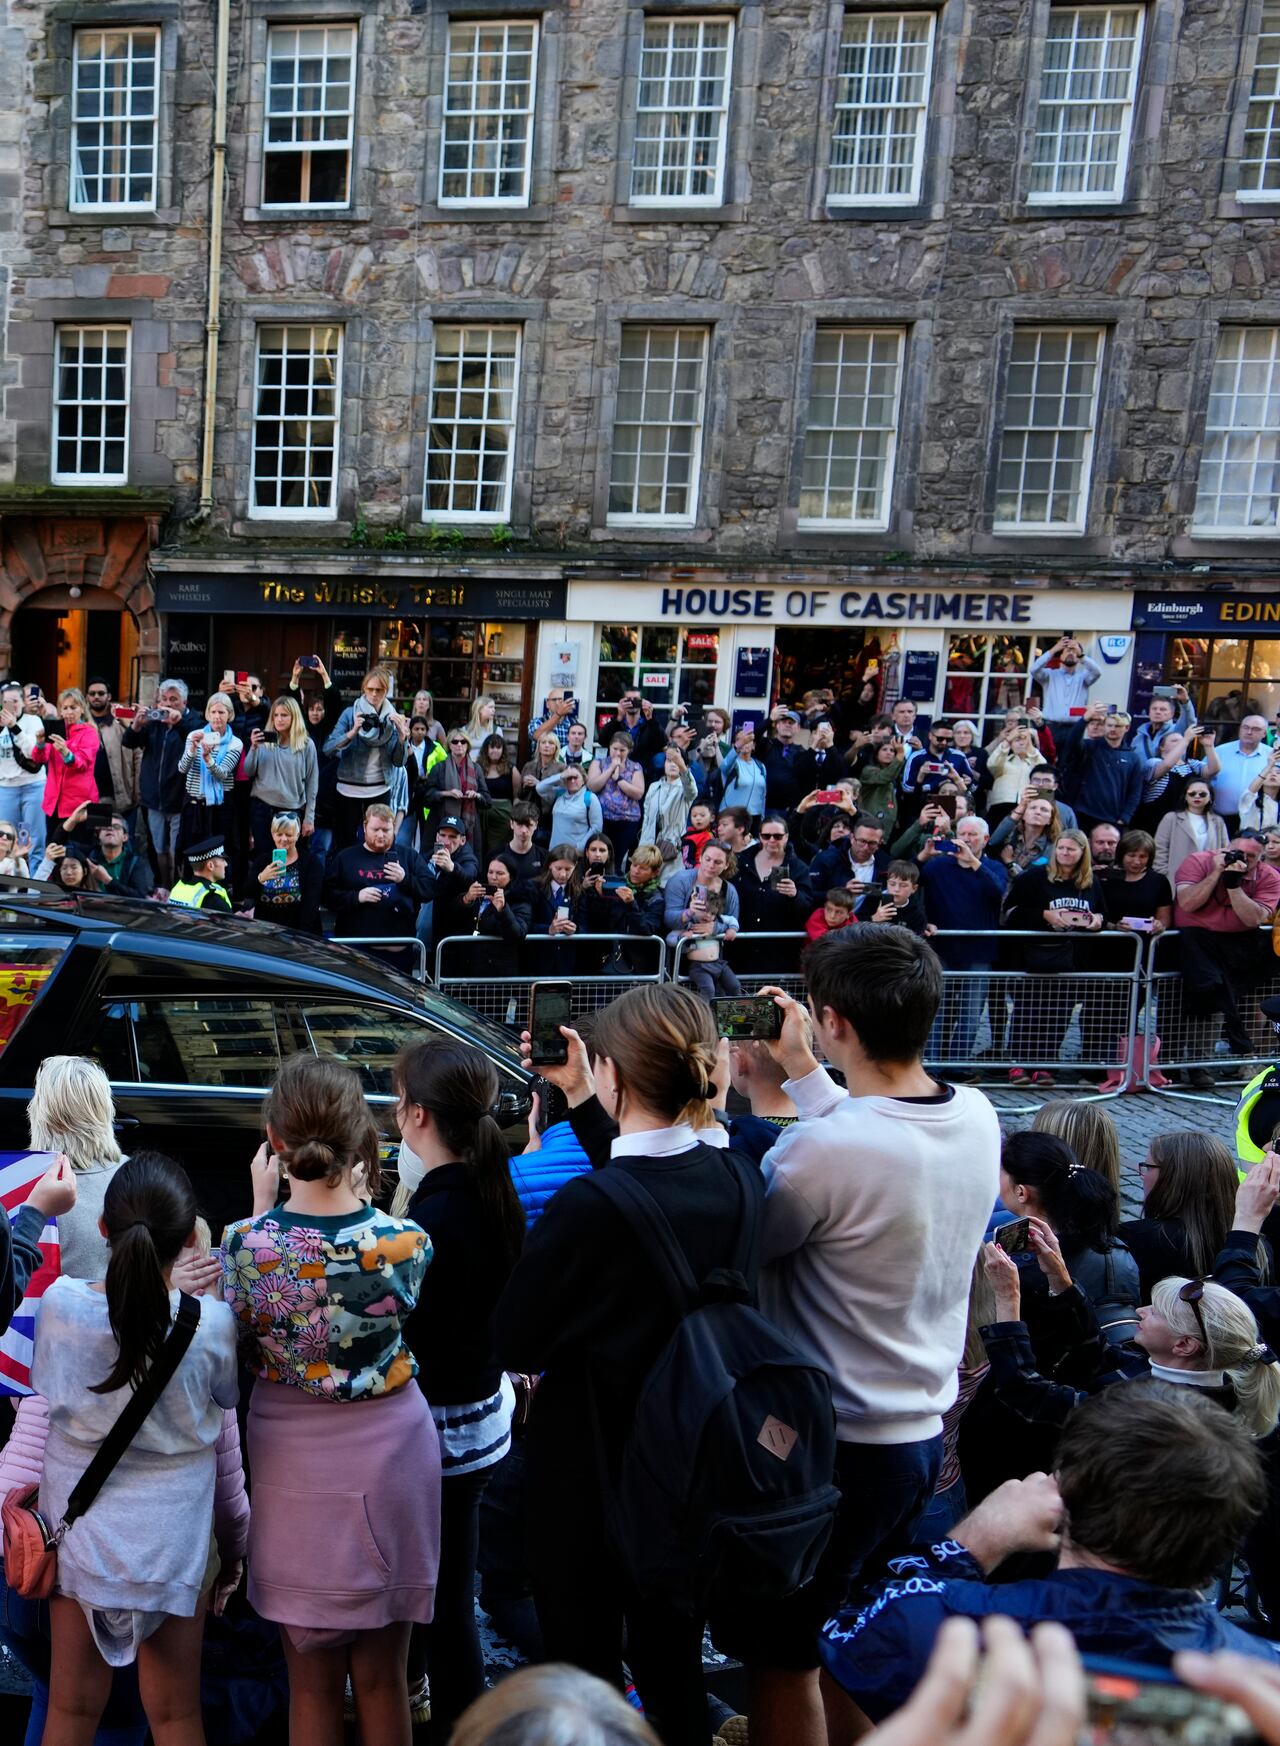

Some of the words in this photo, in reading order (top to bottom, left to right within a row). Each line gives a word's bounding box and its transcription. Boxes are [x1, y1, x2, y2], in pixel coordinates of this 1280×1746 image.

[179, 584, 200, 592] RARE
[169, 592, 211, 601] WHISKIES
[260, 581, 305, 603] The
[312, 582, 398, 609] Whisky
[409, 583, 464, 606] Trail
[496, 590, 526, 599] SINGLE
[529, 590, 553, 599] MALT
[497, 599, 550, 608] SPECIALISTS
[661, 588, 775, 617] HOUSE
[785, 590, 830, 617] OF
[840, 591, 1033, 622] CASHMERE
[1148, 602, 1203, 615] Edinburgh
[690, 637, 713, 646] SALE
[334, 645, 367, 653] HIGHLAND
[645, 676, 667, 684] SALE
[1049, 897, 1090, 911] ARIZONA
